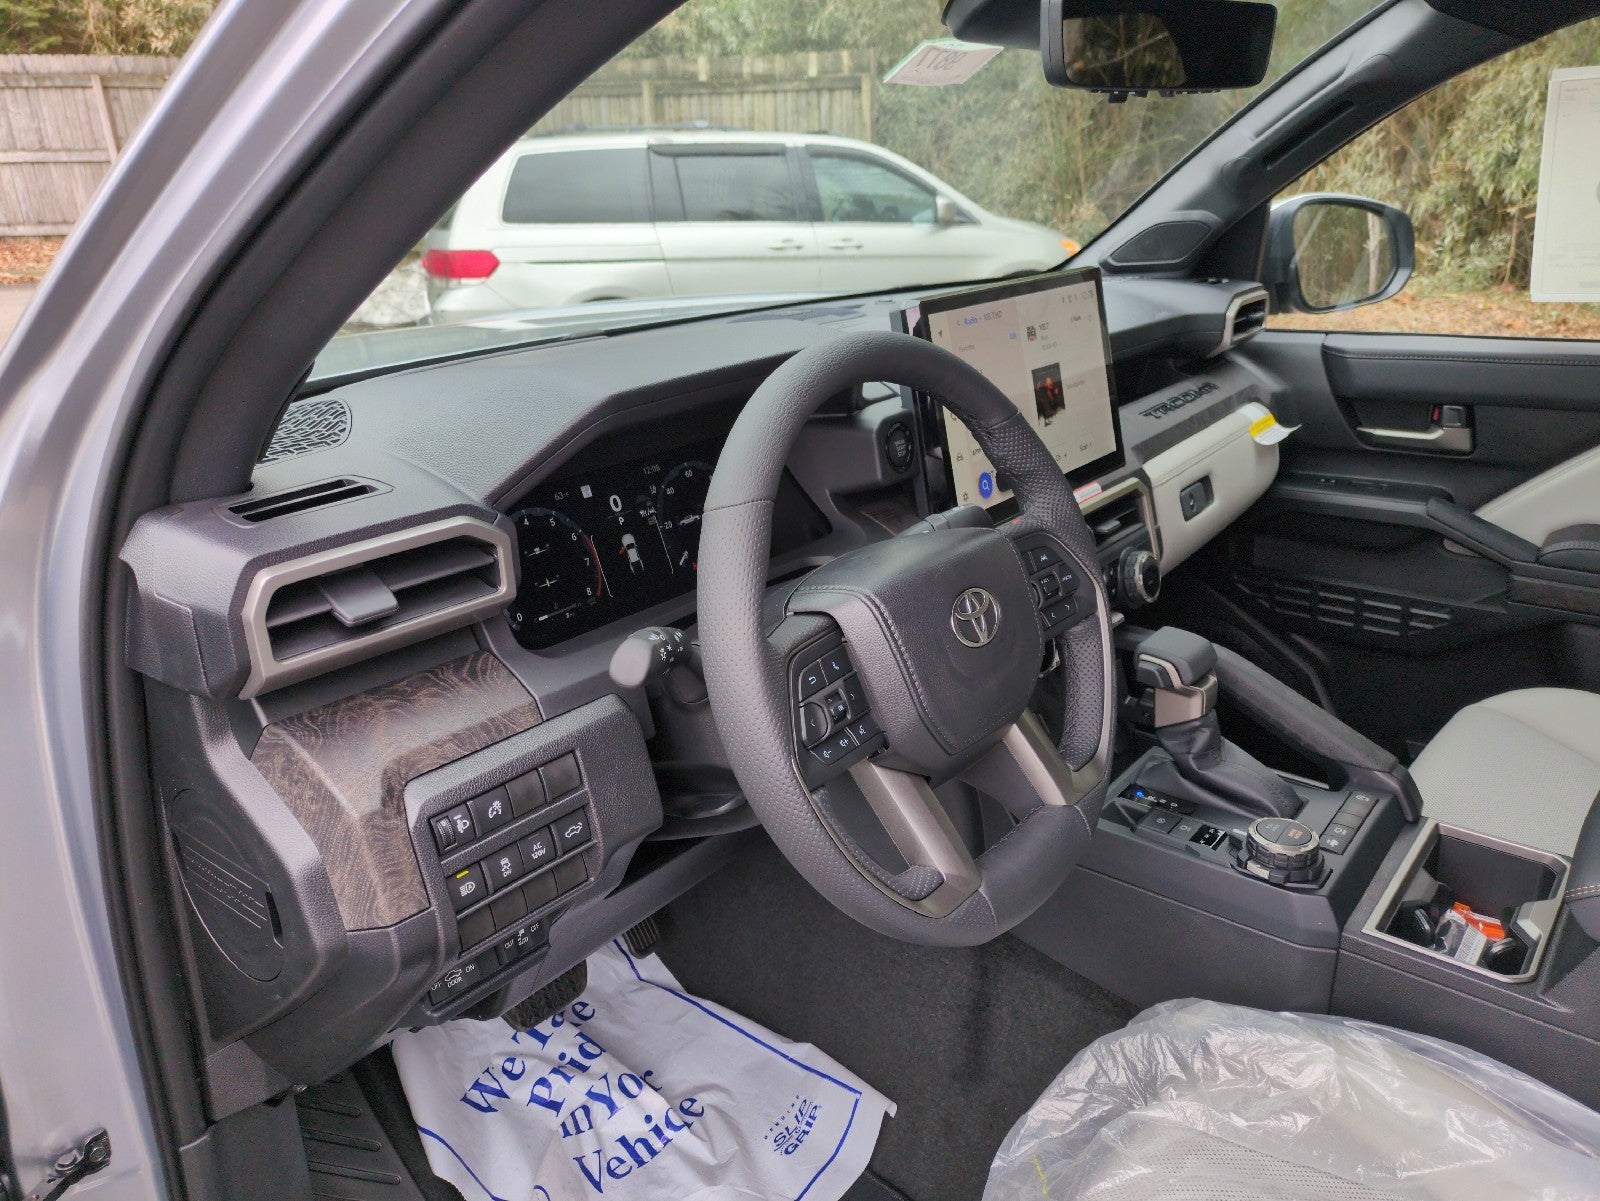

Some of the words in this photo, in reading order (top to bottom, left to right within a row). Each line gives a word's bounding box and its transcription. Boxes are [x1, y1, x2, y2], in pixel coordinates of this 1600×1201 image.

[609, 494, 622, 512] 0
[550, 517, 556, 527] 5
[571, 533, 577, 541] 6
[584, 557, 590, 567] 7
[586, 587, 592, 596] 8
[516, 612, 523, 622] 0
[533, 842, 543, 852] AC
[465, 963, 476, 973] ON
[447, 976, 464, 989] DOOR
[459, 1056, 526, 1113] We
[510, 1001, 596, 1051] Te
[527, 1031, 607, 1118] Prid
[585, 1069, 663, 1121] Yor
[773, 1099, 807, 1147] SLIP
[784, 1105, 818, 1155] GRIP
[572, 1097, 705, 1194] Vehice
